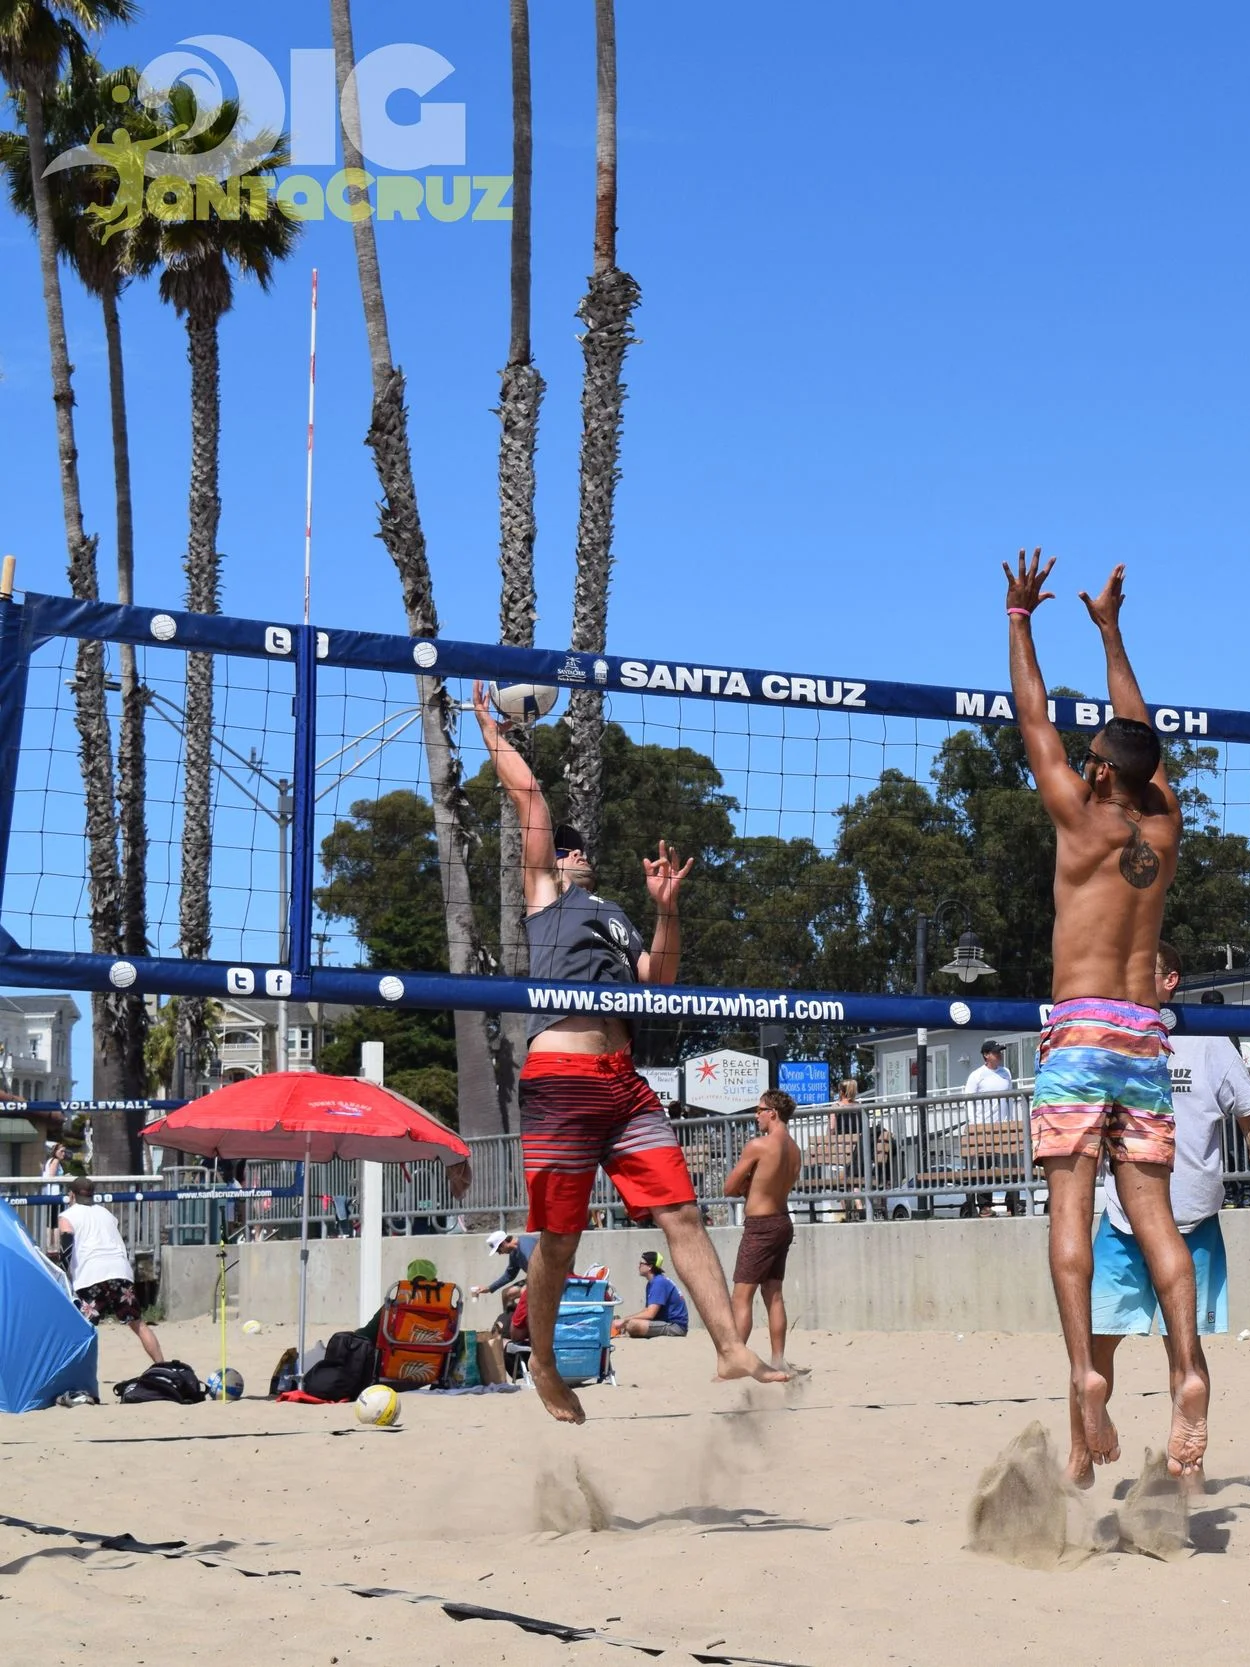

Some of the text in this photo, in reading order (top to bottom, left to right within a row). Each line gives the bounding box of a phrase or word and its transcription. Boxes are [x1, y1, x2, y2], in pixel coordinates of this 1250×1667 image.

[620, 661, 866, 706] SANTA CRUZ
[955, 691, 1208, 734] MA BCH
[527, 987, 845, 1021] www.santacruzwharf.com
[722, 1059, 760, 1068] BEACH
[722, 1068, 760, 1078] STREET
[724, 1077, 744, 1085] INN
[723, 1085, 760, 1095] SUITES
[807, 1082, 828, 1092] SUITES
[60, 1100, 152, 1110] VOLLEYBALL
